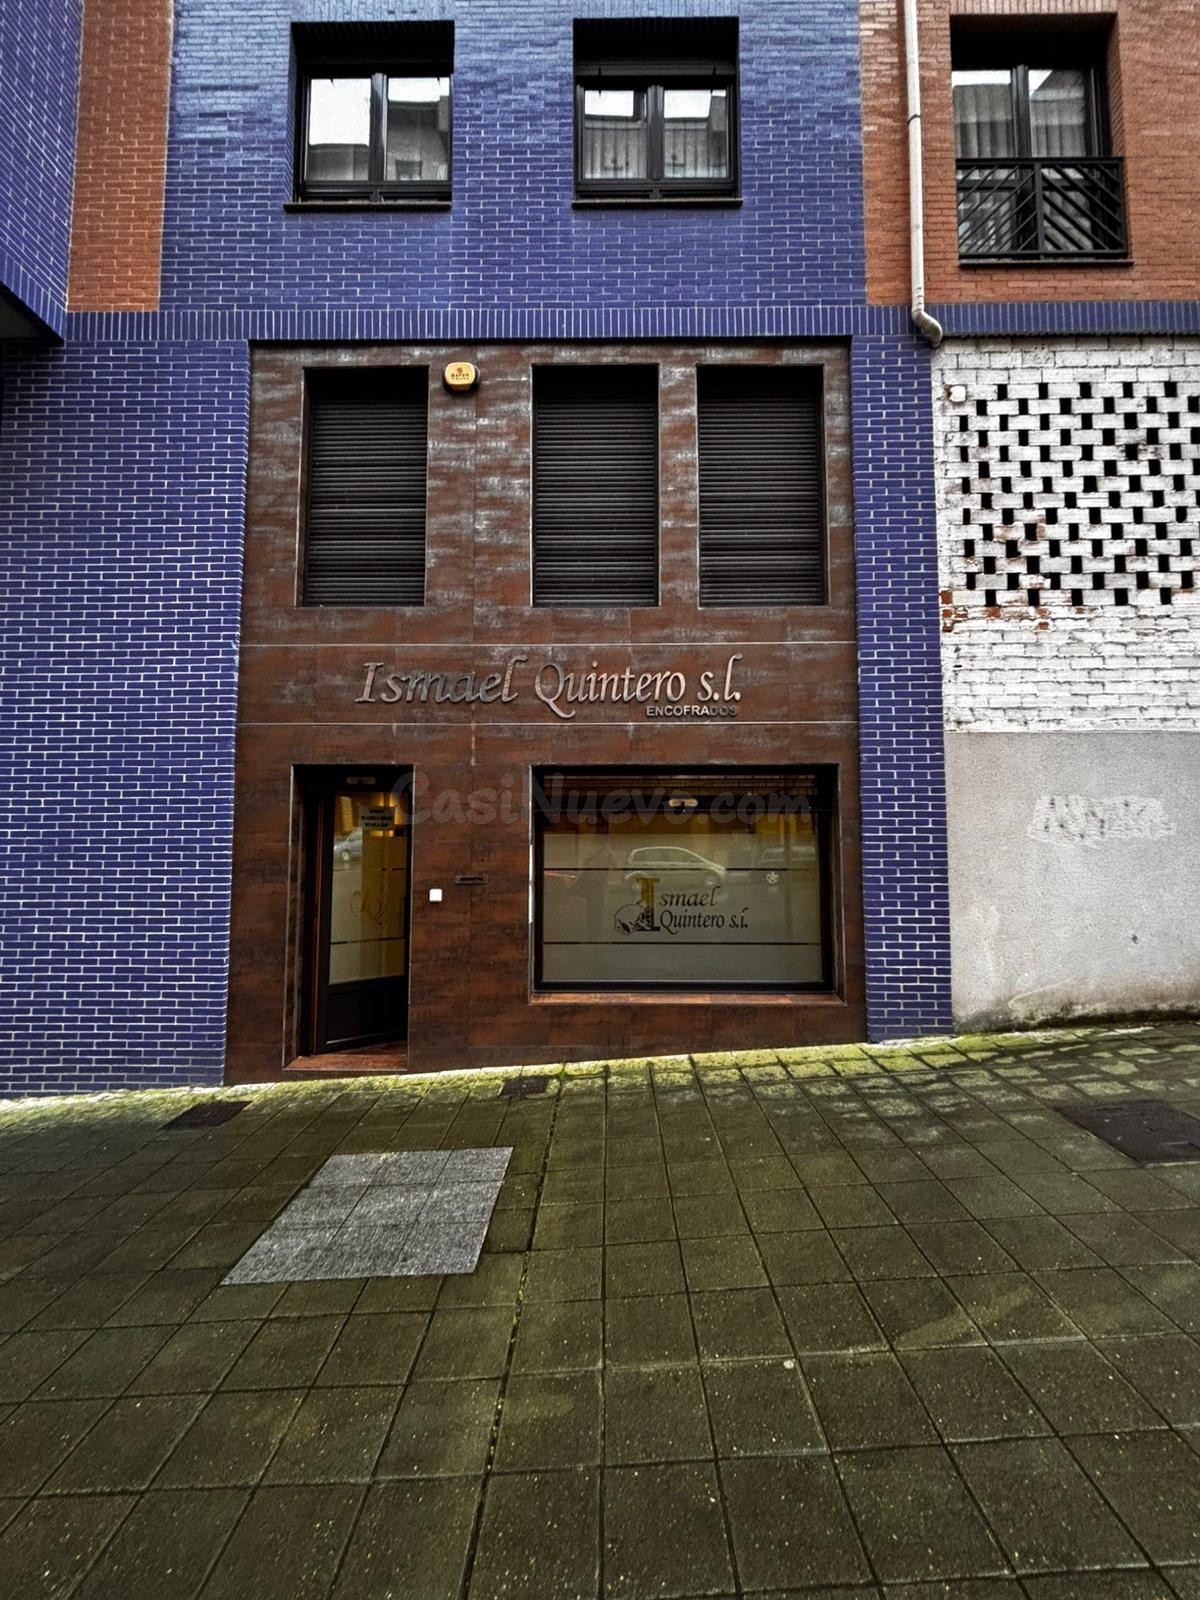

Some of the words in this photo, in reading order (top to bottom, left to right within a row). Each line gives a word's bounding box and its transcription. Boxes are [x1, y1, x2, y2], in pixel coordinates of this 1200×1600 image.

[355, 654, 527, 702] Ismael
[534, 660, 687, 719] Quintero
[697, 652, 743, 701] s.l.
[646, 704, 737, 717] ENCOFRADOS
[659, 909, 726, 935] Quintero
